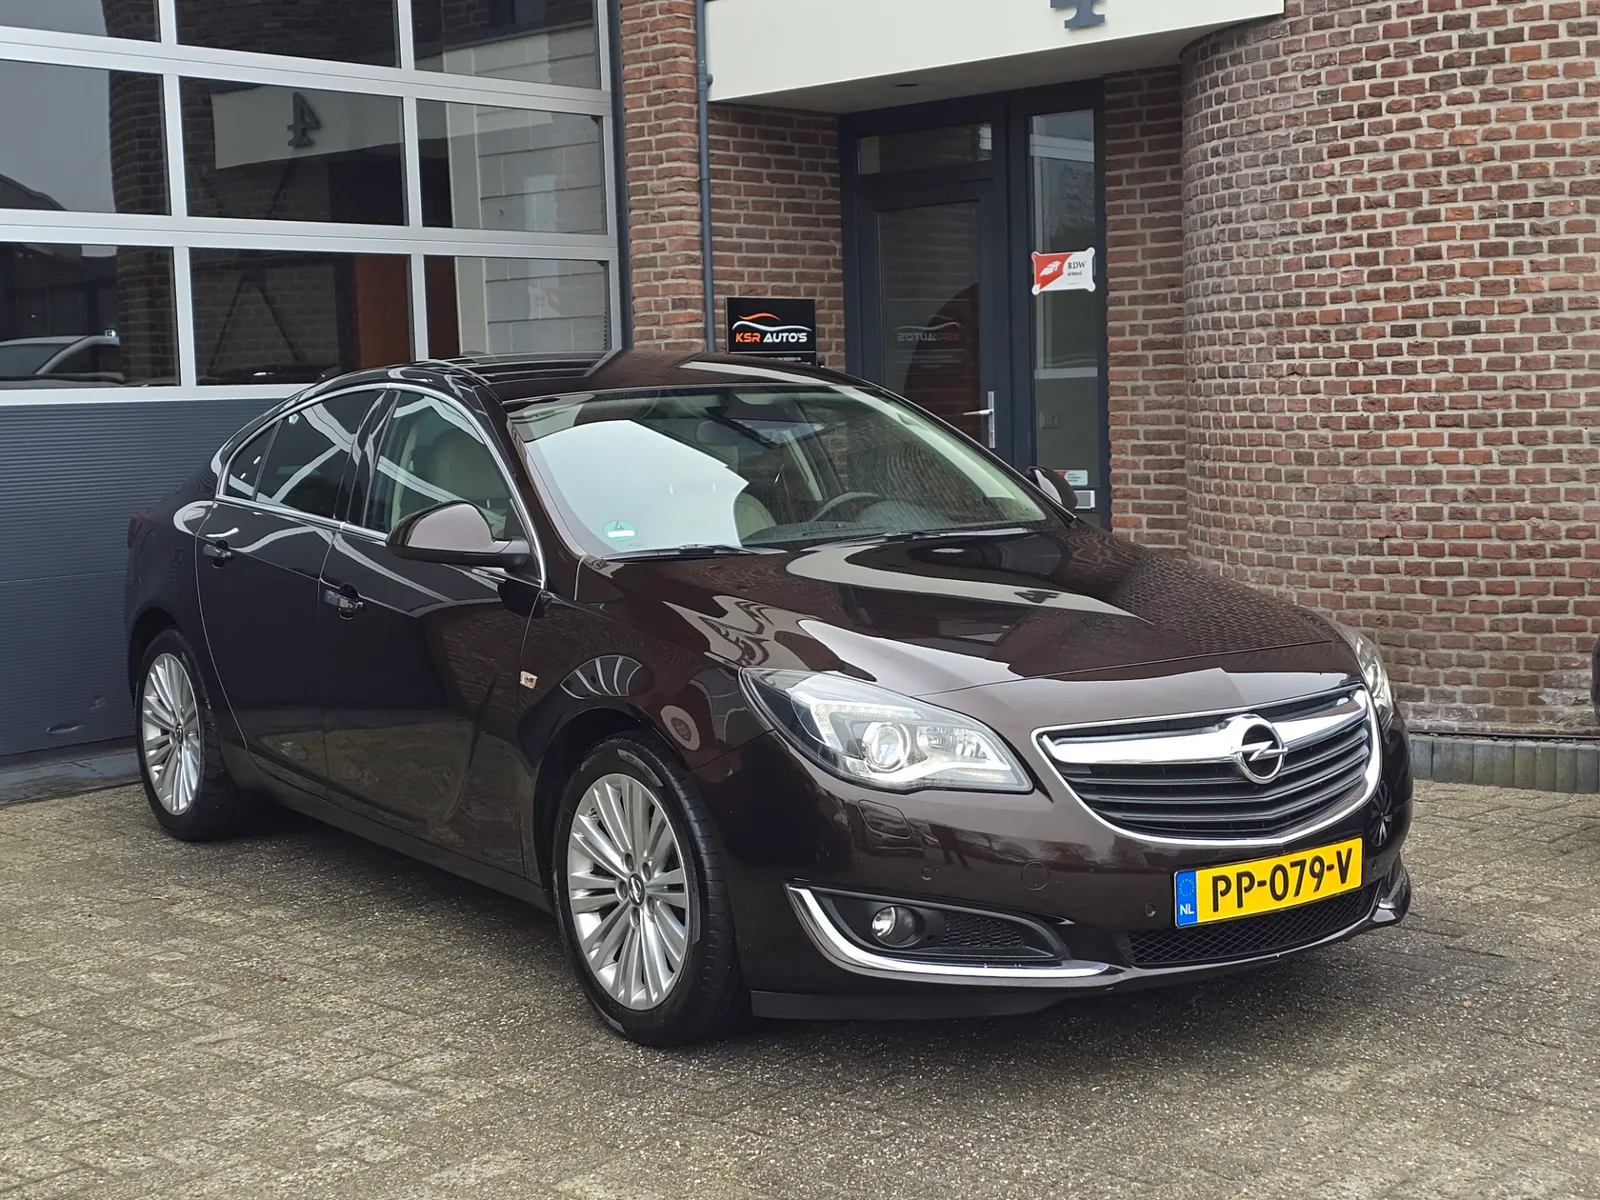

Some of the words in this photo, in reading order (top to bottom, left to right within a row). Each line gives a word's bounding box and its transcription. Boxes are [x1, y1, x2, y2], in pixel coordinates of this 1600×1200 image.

[1067, 260, 1087, 269] RDW
[735, 332, 761, 343] KSR
[763, 332, 808, 343] AUTO'S
[1179, 903, 1195, 916] NL
[1211, 848, 1353, 913] PP-079-V
